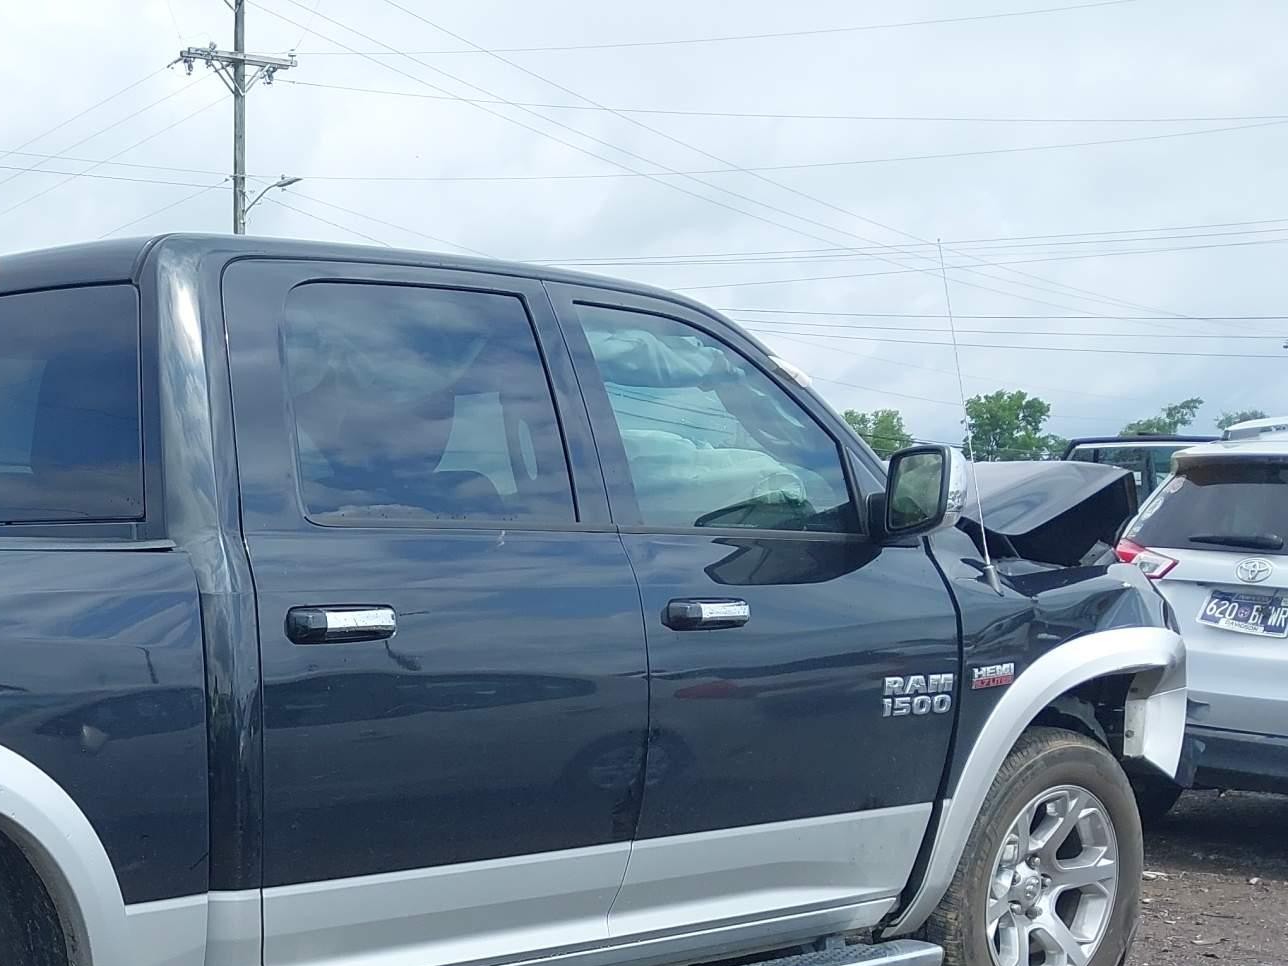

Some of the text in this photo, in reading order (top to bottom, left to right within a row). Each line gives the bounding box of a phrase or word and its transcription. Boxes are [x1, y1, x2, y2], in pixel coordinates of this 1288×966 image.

[1206, 599, 1239, 619] 620
[972, 662, 1015, 680] HEMI
[884, 673, 955, 696] RAM
[882, 694, 952, 717] 1500
